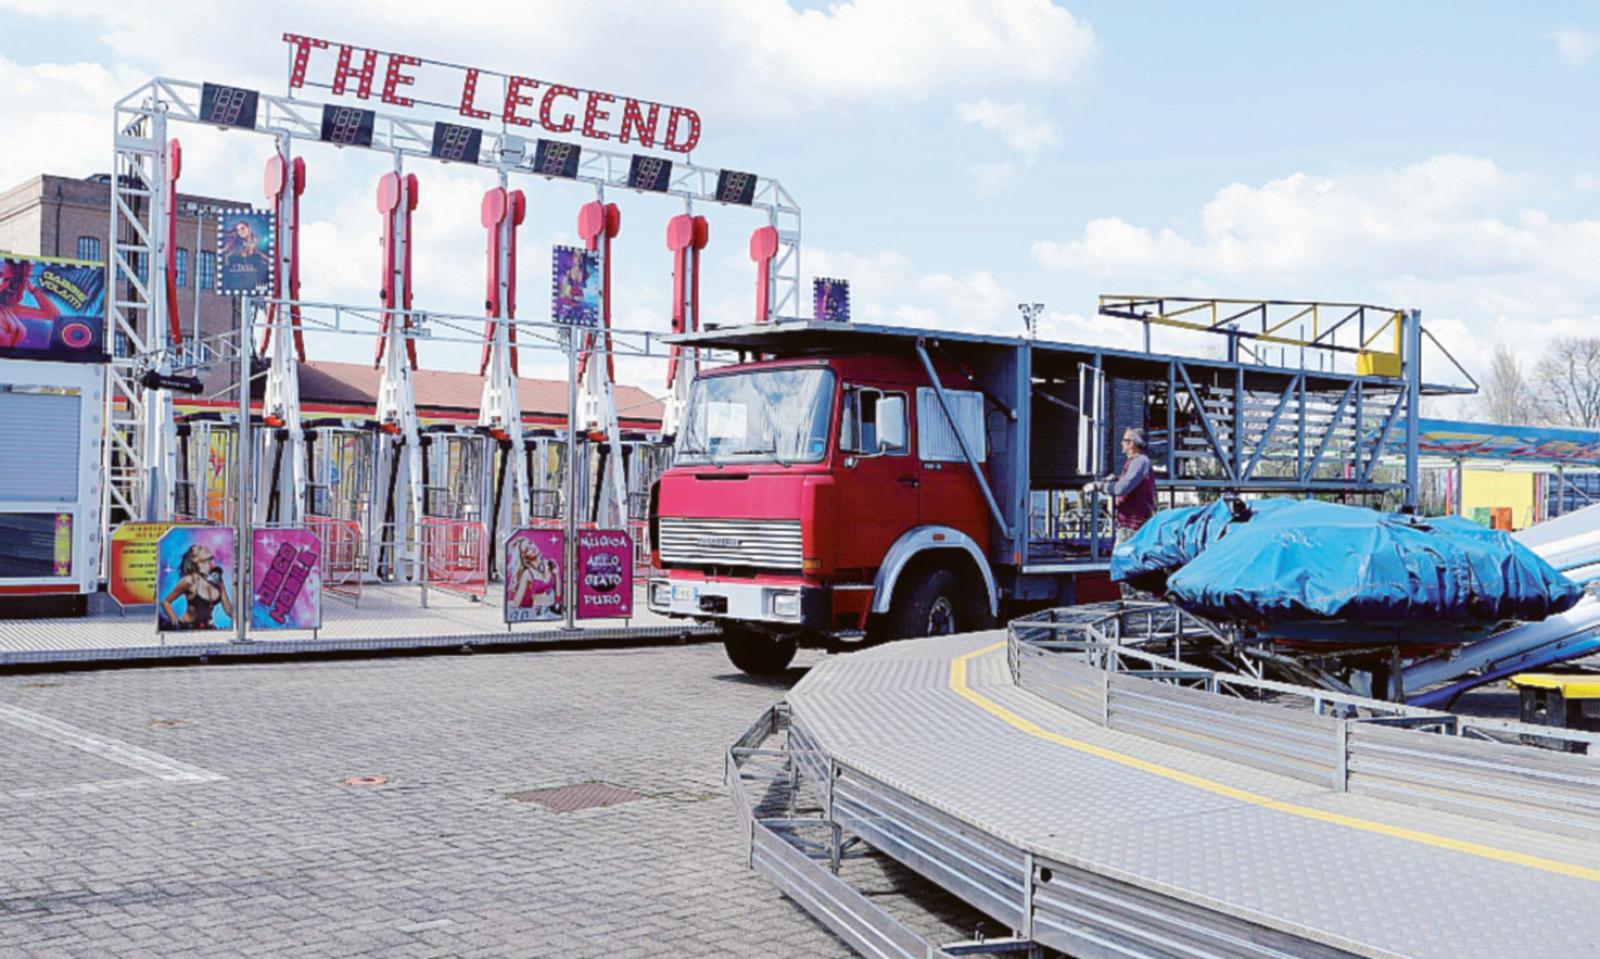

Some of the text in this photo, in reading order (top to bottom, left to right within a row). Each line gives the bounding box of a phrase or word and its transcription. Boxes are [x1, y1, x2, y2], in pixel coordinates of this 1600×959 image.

[282, 33, 701, 154] THE LEGEND
[583, 593, 621, 607] PURO
